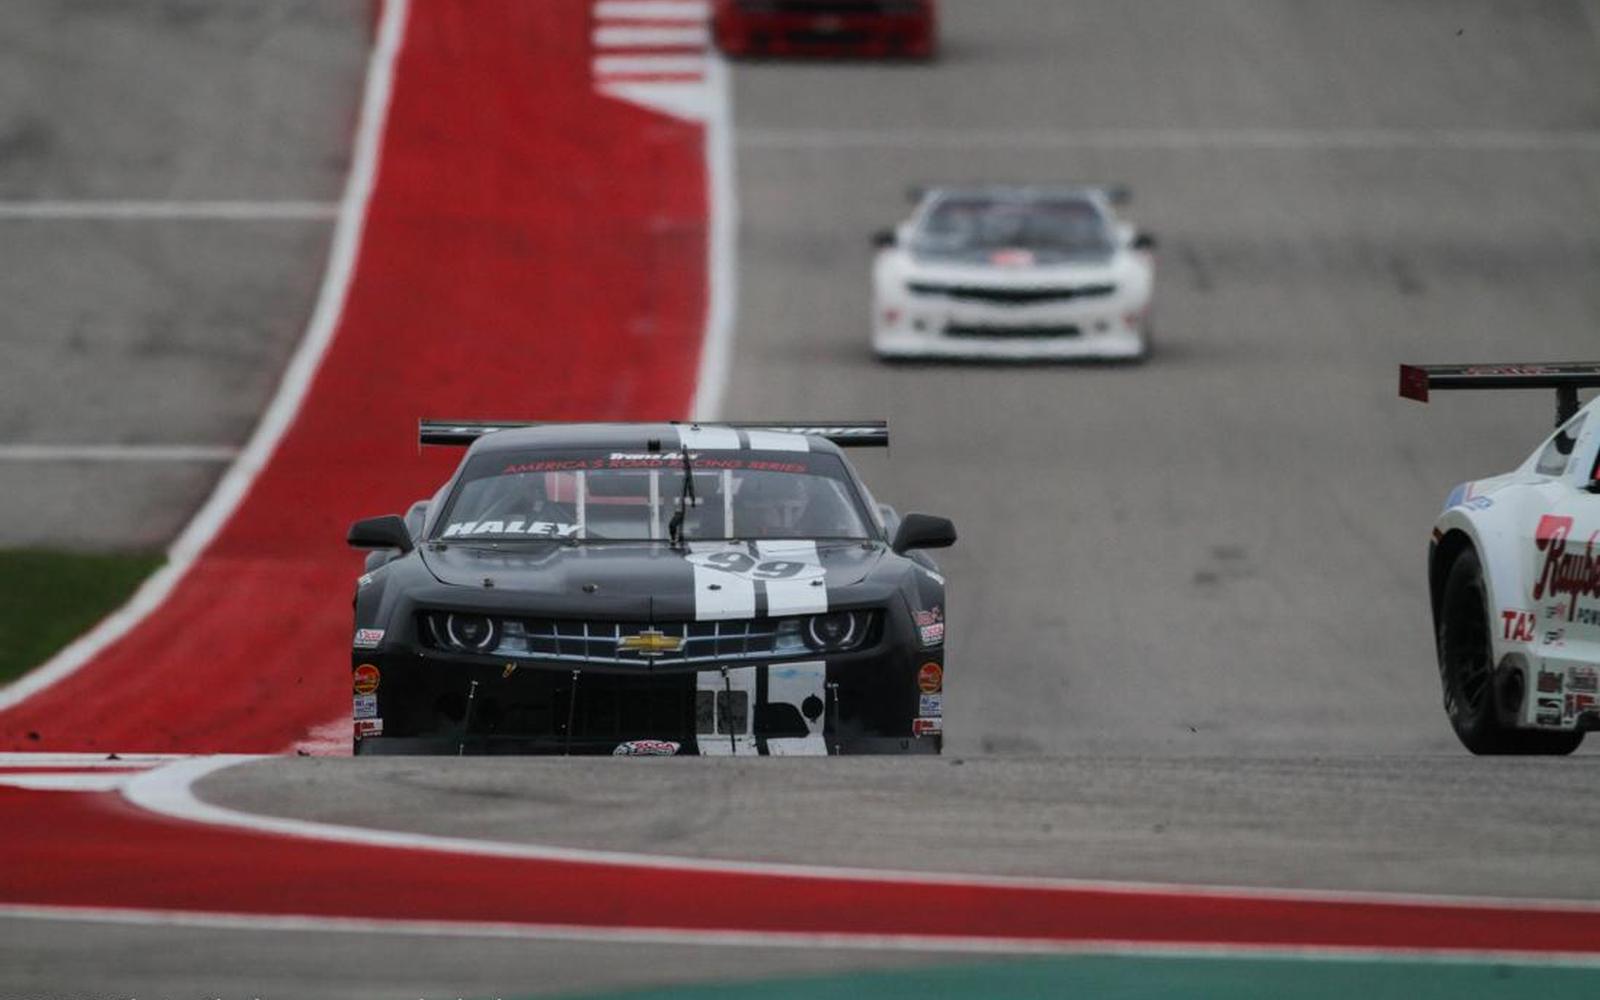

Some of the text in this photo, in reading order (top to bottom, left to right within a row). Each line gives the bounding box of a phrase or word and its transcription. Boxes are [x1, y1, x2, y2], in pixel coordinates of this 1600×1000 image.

[609, 452, 662, 461] Trans
[608, 459, 663, 469] ROAD
[748, 460, 809, 474] SERIES
[443, 520, 581, 538] HALEY
[702, 551, 806, 579] 99
[1502, 610, 1536, 641] TA2
